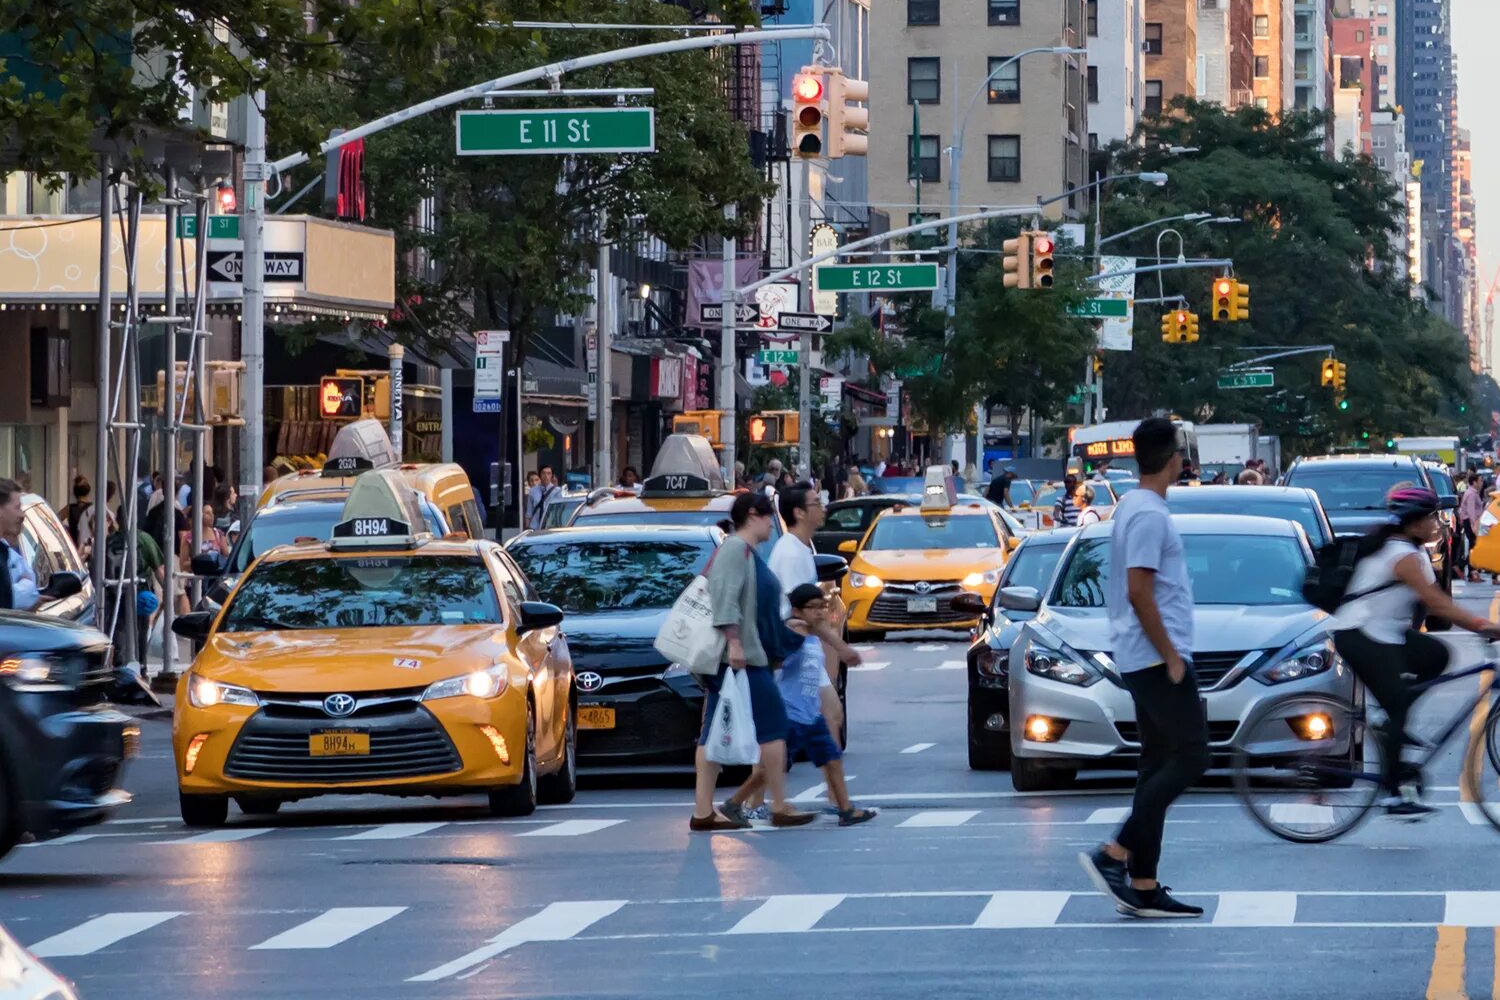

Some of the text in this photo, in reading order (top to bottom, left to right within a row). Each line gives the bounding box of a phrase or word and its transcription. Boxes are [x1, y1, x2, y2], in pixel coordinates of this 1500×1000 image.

[519, 118, 591, 143] E 11 St
[184, 218, 194, 236] E
[816, 237, 834, 248] BAR
[224, 260, 294, 274] ON WAY
[852, 269, 902, 286] E 12 St
[1090, 301, 1102, 314] St
[785, 316, 826, 330] ONE WAY
[763, 350, 770, 362] E
[773, 350, 784, 362] 12
[665, 475, 688, 490] 7C47
[354, 518, 388, 535] 8H94
